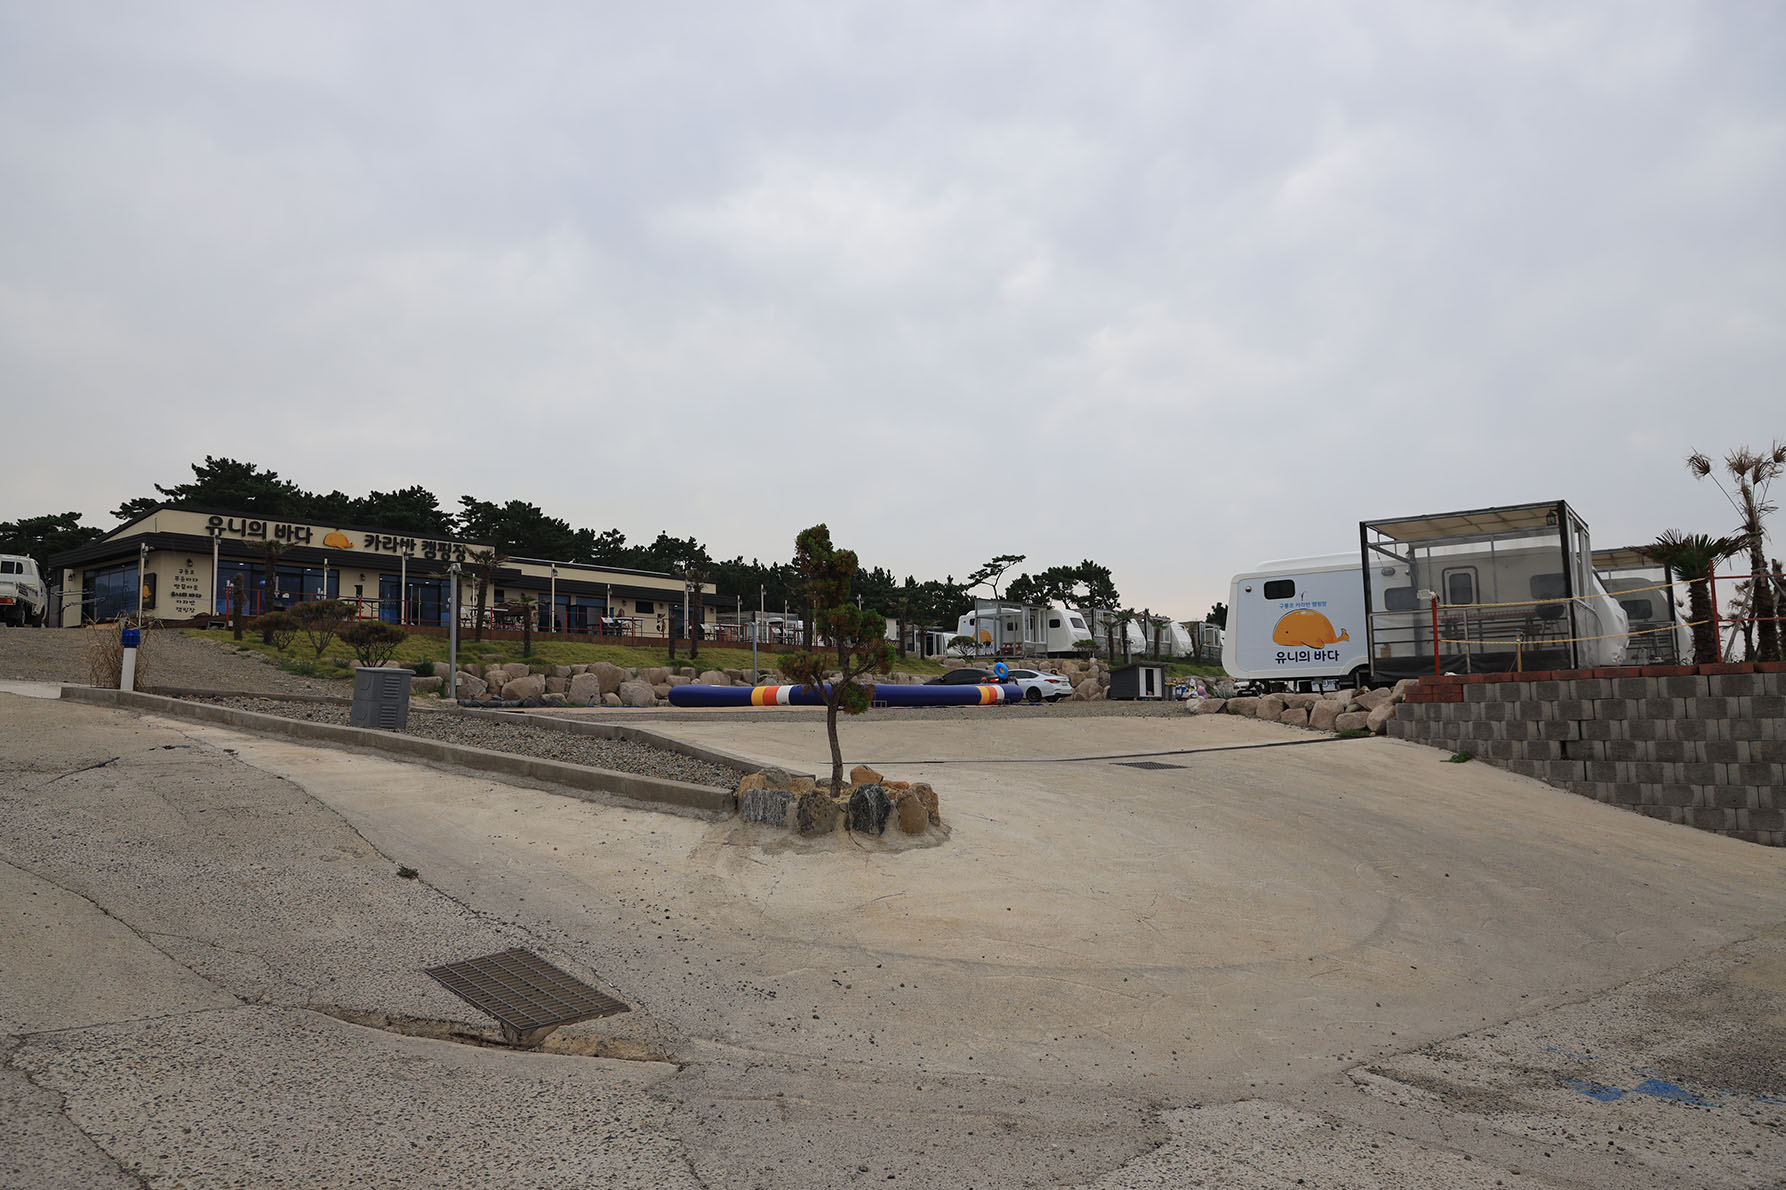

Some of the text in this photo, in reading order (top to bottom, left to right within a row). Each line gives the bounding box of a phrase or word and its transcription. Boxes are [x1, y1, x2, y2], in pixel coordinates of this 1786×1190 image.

[206, 515, 313, 544] 유니의 바다
[364, 534, 467, 562] 카라반 캠핑장
[1274, 650, 1340, 665] 유니의 바다
